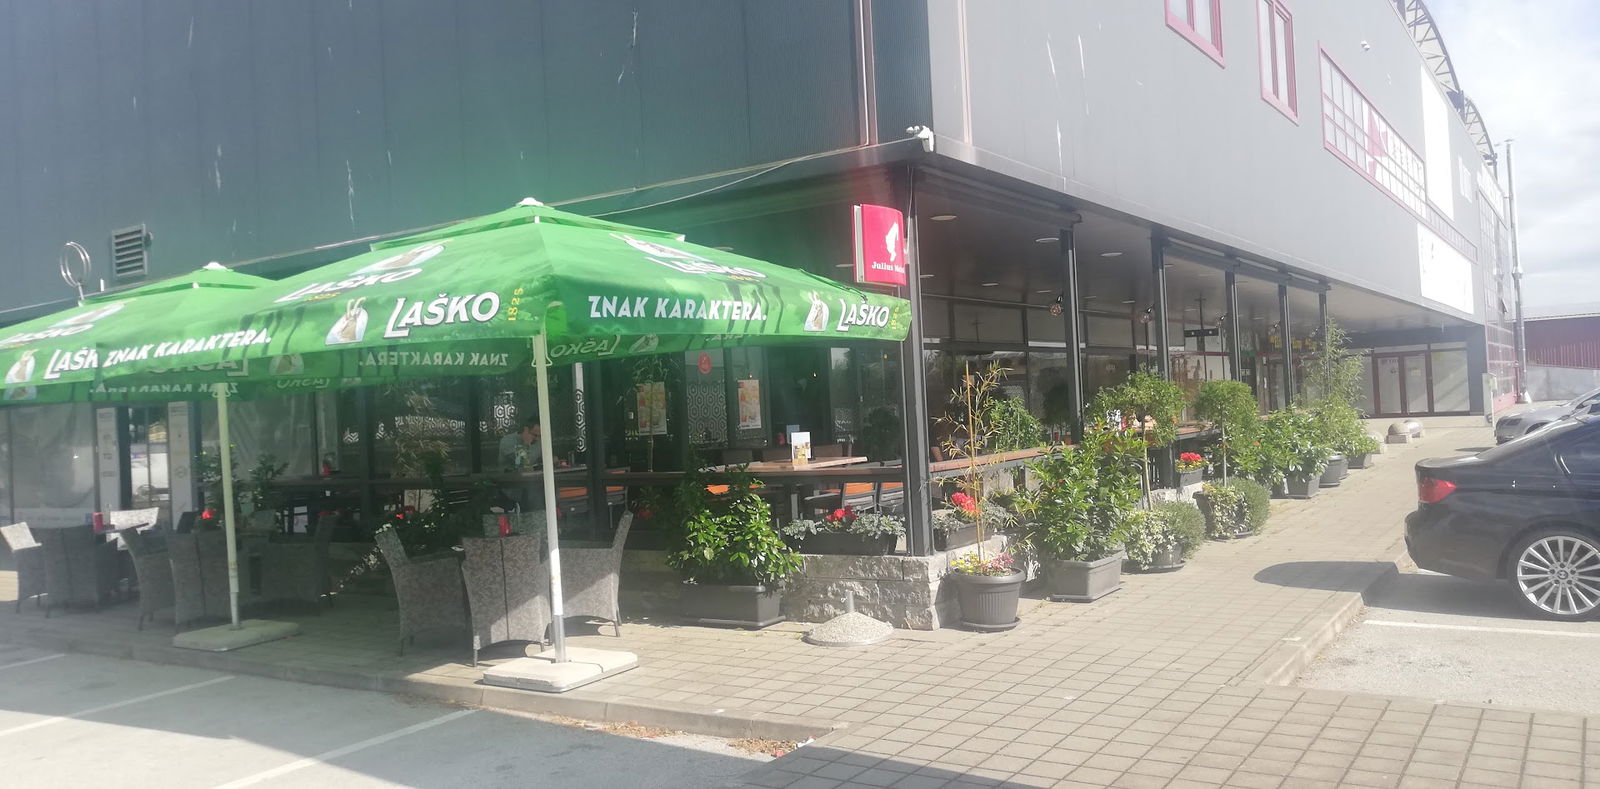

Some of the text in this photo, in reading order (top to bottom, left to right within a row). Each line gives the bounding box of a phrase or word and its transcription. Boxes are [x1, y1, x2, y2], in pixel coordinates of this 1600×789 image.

[871, 261, 894, 271] Julius
[383, 292, 501, 339] LAŠKO
[507, 287, 524, 321] 1825
[588, 296, 768, 322] ZNAK KARAKTERA.
[837, 299, 890, 332] LAŠKO
[102, 327, 272, 368] ZNAK KARAKTERA.
